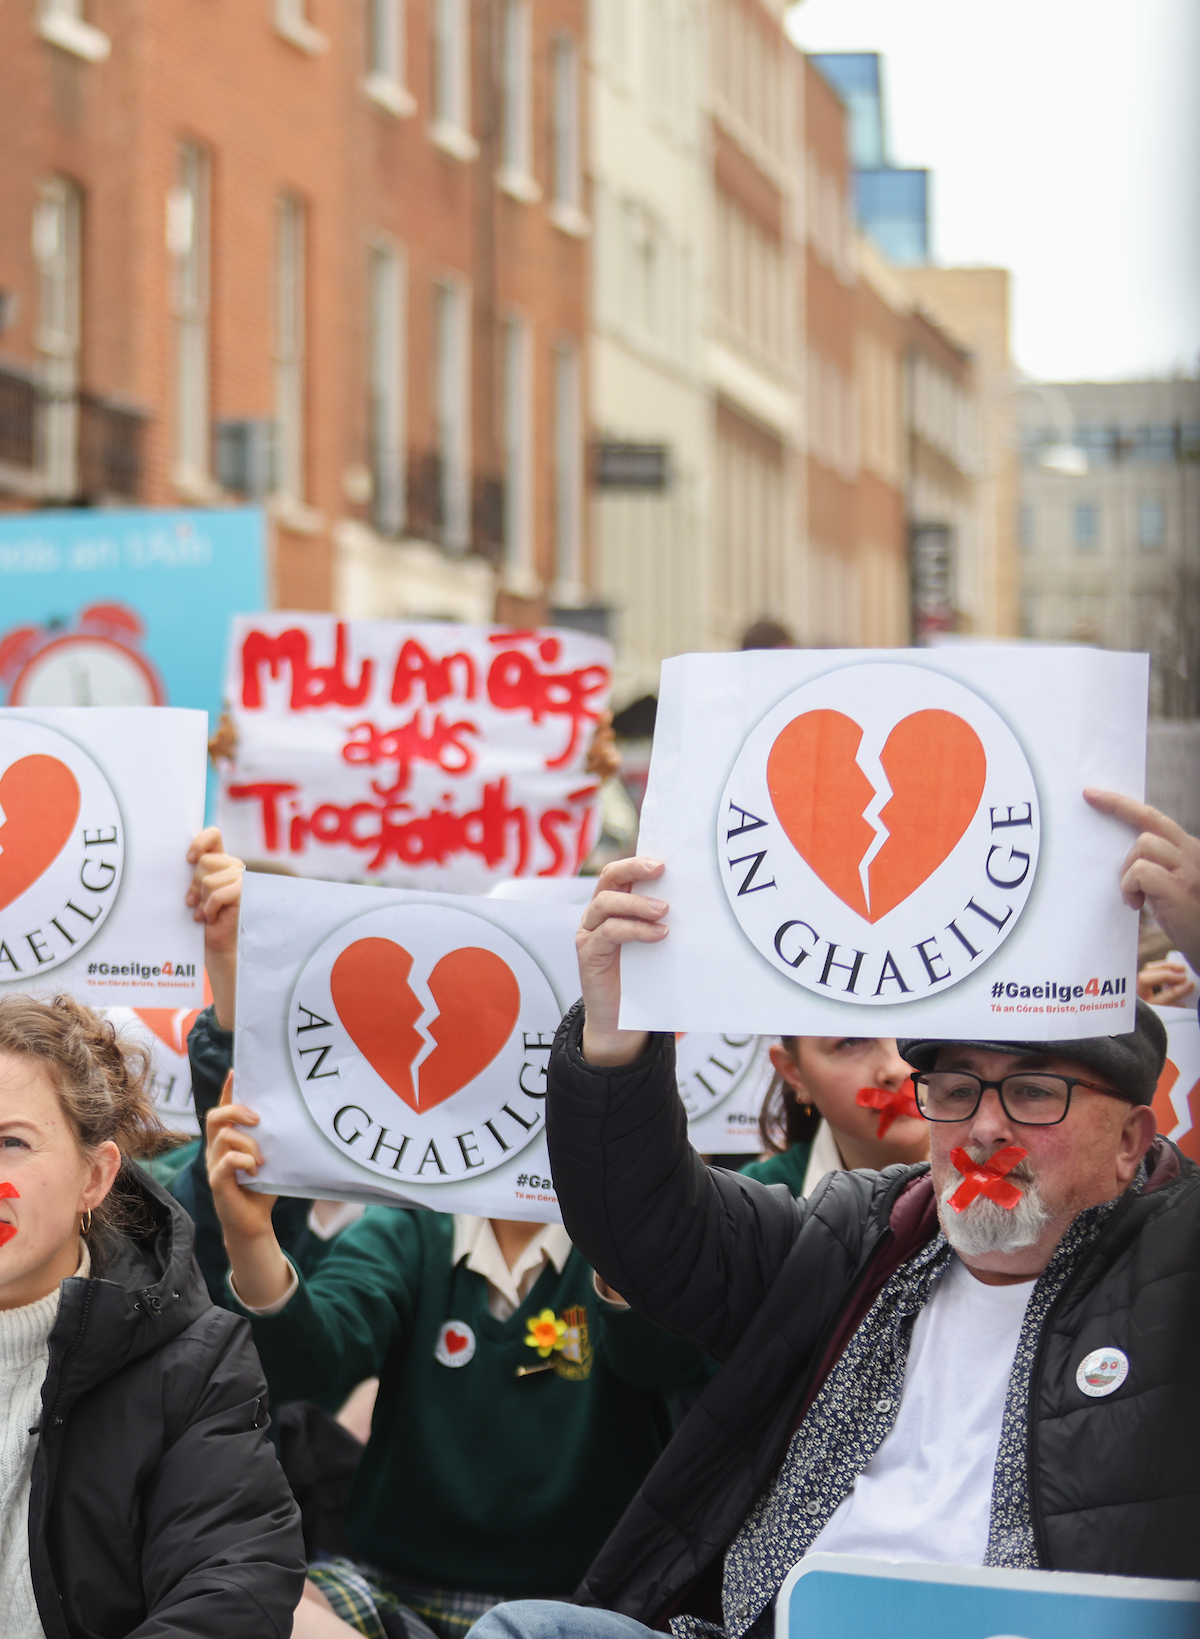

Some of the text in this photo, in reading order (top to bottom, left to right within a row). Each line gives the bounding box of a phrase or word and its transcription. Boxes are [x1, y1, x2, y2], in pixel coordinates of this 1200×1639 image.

[392, 639, 477, 704] An
[726, 798, 1033, 997] AN GHAEILGE
[87, 961, 196, 980] #Gaeilge4All
[991, 977, 1126, 1003] #Gaeilge4All
[991, 998, 1126, 1014] Tá an Córas Briste, Deisímis É
[296, 1002, 340, 1081] AN
